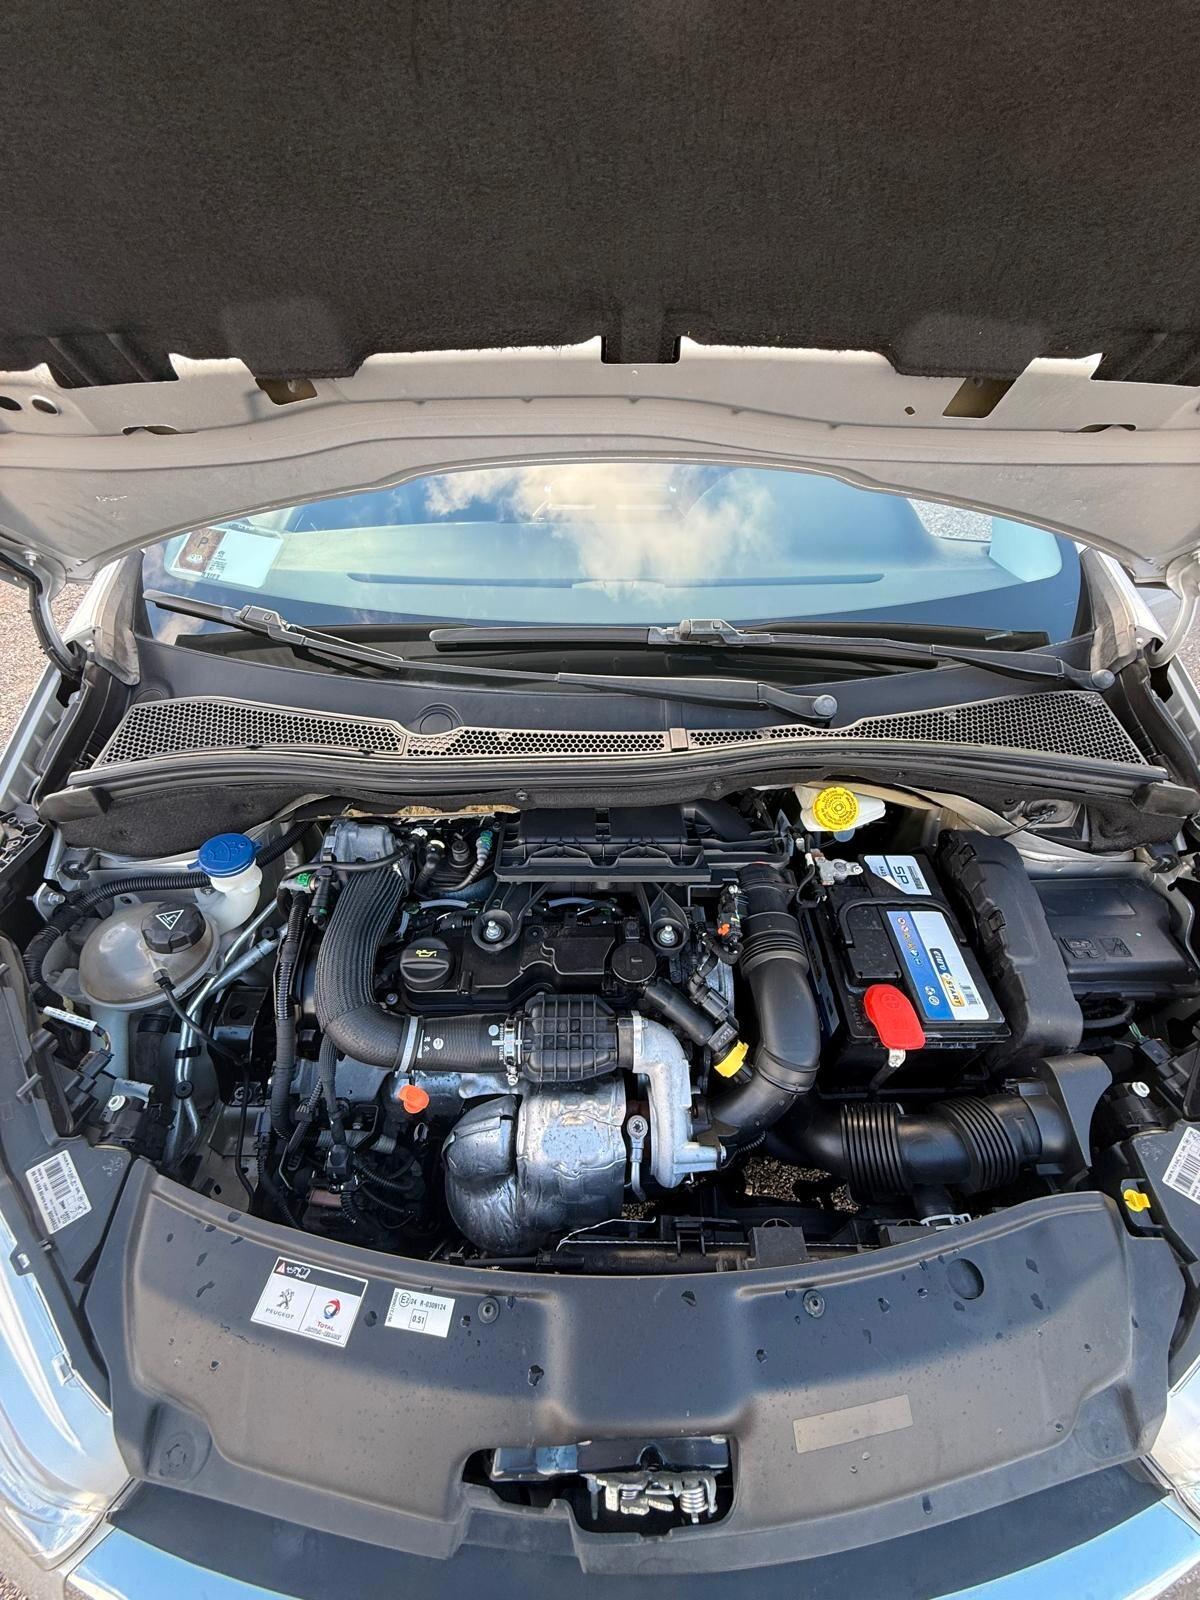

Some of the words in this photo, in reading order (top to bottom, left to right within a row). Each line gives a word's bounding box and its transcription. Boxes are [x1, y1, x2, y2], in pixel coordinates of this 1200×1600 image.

[944, 979, 963, 1006] START
[265, 1307, 295, 1320] PEUGEOT
[317, 1321, 335, 1332] TOTAL
